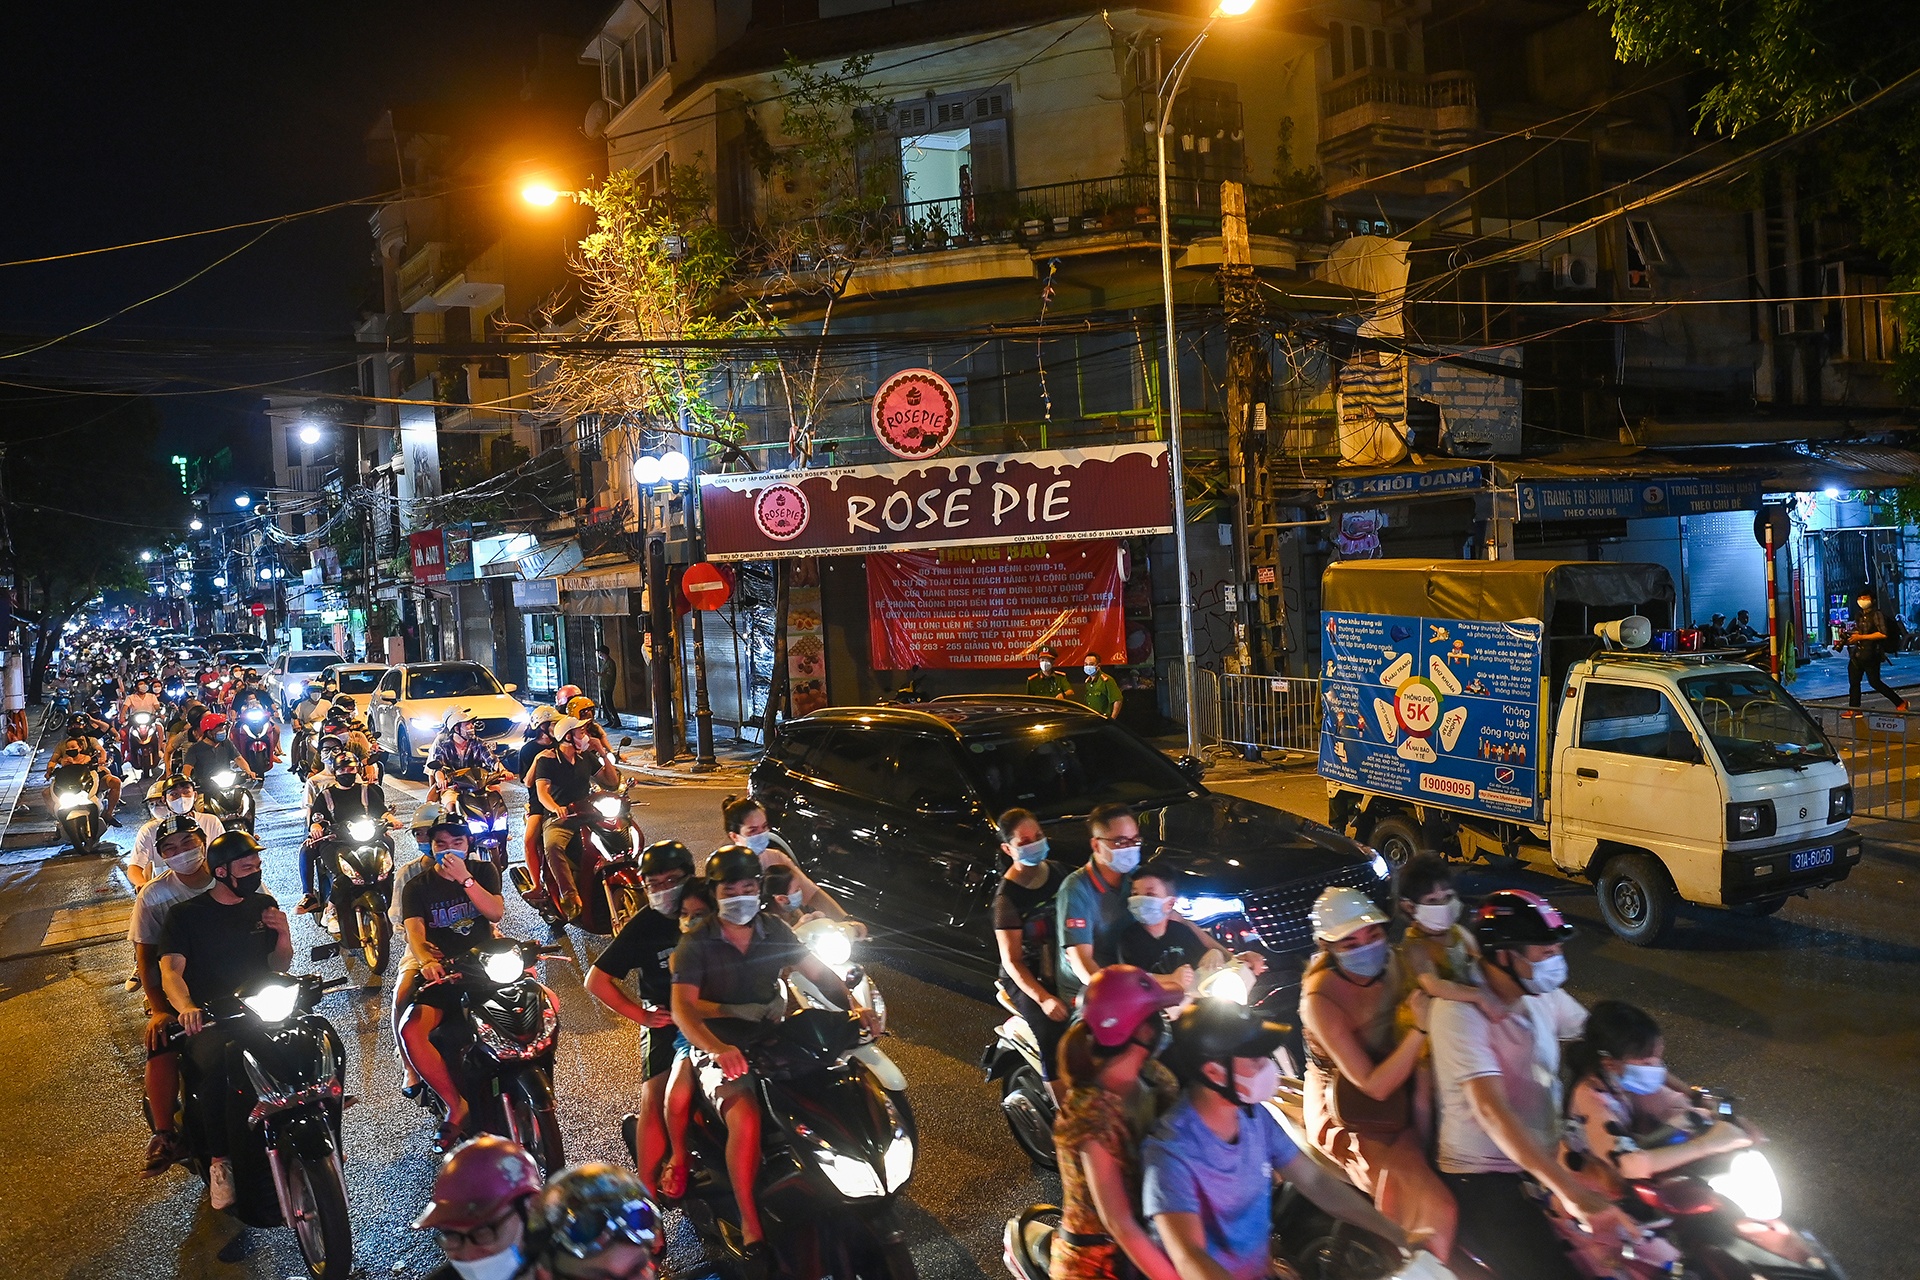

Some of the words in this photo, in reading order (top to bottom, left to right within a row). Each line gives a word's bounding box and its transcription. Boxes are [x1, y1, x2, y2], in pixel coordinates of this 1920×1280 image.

[887, 410, 944, 430] ROSEPIE
[1362, 476, 1412, 492] KHÔI
[1419, 471, 1474, 487] OANH
[1542, 490, 1572, 506] TRANG
[1589, 488, 1610, 504] SINH
[1670, 485, 1698, 496] TRANG
[1523, 488, 1535, 510] 3
[1690, 500, 1710, 512] THEO
[847, 488, 972, 534] ROSE
[992, 480, 1072, 526] PIE
[1563, 508, 1584, 518] THEO
[764, 508, 800, 521] ROSEPIE
[954, 566, 974, 574] HÌNH
[976, 565, 996, 574] DỊCH
[998, 563, 1022, 574] BỆNH
[930, 578, 951, 586] TOÀN
[953, 576, 970, 585] CỦA
[972, 575, 1000, 584] KHÁCH
[1004, 574, 1027, 583] HÀNG
[1043, 572, 1067, 582] CỘNG
[923, 588, 946, 597] HÀNG
[948, 588, 970, 596] ROSE
[972, 588, 986, 596] PIE
[990, 587, 1006, 596] TẠM
[1009, 585, 1032, 594] DỪNG
[1035, 584, 1058, 594] HOẠT
[1060, 584, 1084, 594] ĐỘNG
[918, 598, 946, 608] CHỐNG
[948, 600, 968, 608] DỊCH
[970, 598, 987, 606] ĐẾN
[990, 598, 1004, 606] KHI
[1021, 595, 1048, 605] THÔNG
[1051, 594, 1068, 604] BÁO
[1072, 592, 1089, 602] TIẾP
[904, 610, 931, 618] KHÁCH
[933, 609, 956, 618] HÀNG
[958, 608, 970, 617] CÓ
[972, 609, 990, 617] NHU
[992, 608, 1010, 616] CẦU
[1012, 608, 1032, 616] MUA
[1081, 603, 1106, 612] HÀNG
[903, 621, 916, 629] VUI
[919, 620, 940, 629] LÒNG
[942, 620, 960, 628] LIÊN
[963, 620, 974, 629] HỆ
[976, 618, 988, 628] SỐ
[990, 620, 1028, 628] HOTLINE:
[911, 632, 934, 641] HOẶC
[957, 631, 979, 640] TRỰC
[980, 629, 999, 639] TIẾP
[1002, 630, 1015, 639] TẠI
[1018, 629, 1034, 638] TRỤ
[964, 640, 990, 650] GIẢNG
[1050, 638, 1062, 648] HÀ
[974, 654, 1002, 664] TRỌNG
[1404, 694, 1422, 702] THÔNG
[1422, 696, 1436, 704] ĐIỆP
[1406, 703, 1430, 722] 5K
[1502, 704, 1530, 718] Không
[1506, 718, 1514, 728] tụ
[1516, 718, 1530, 730] tập
[1480, 726, 1502, 738] đông
[1504, 730, 1530, 740] người
[1423, 777, 1470, 796] 19009095
[1795, 848, 1831, 868] 31A-6056
